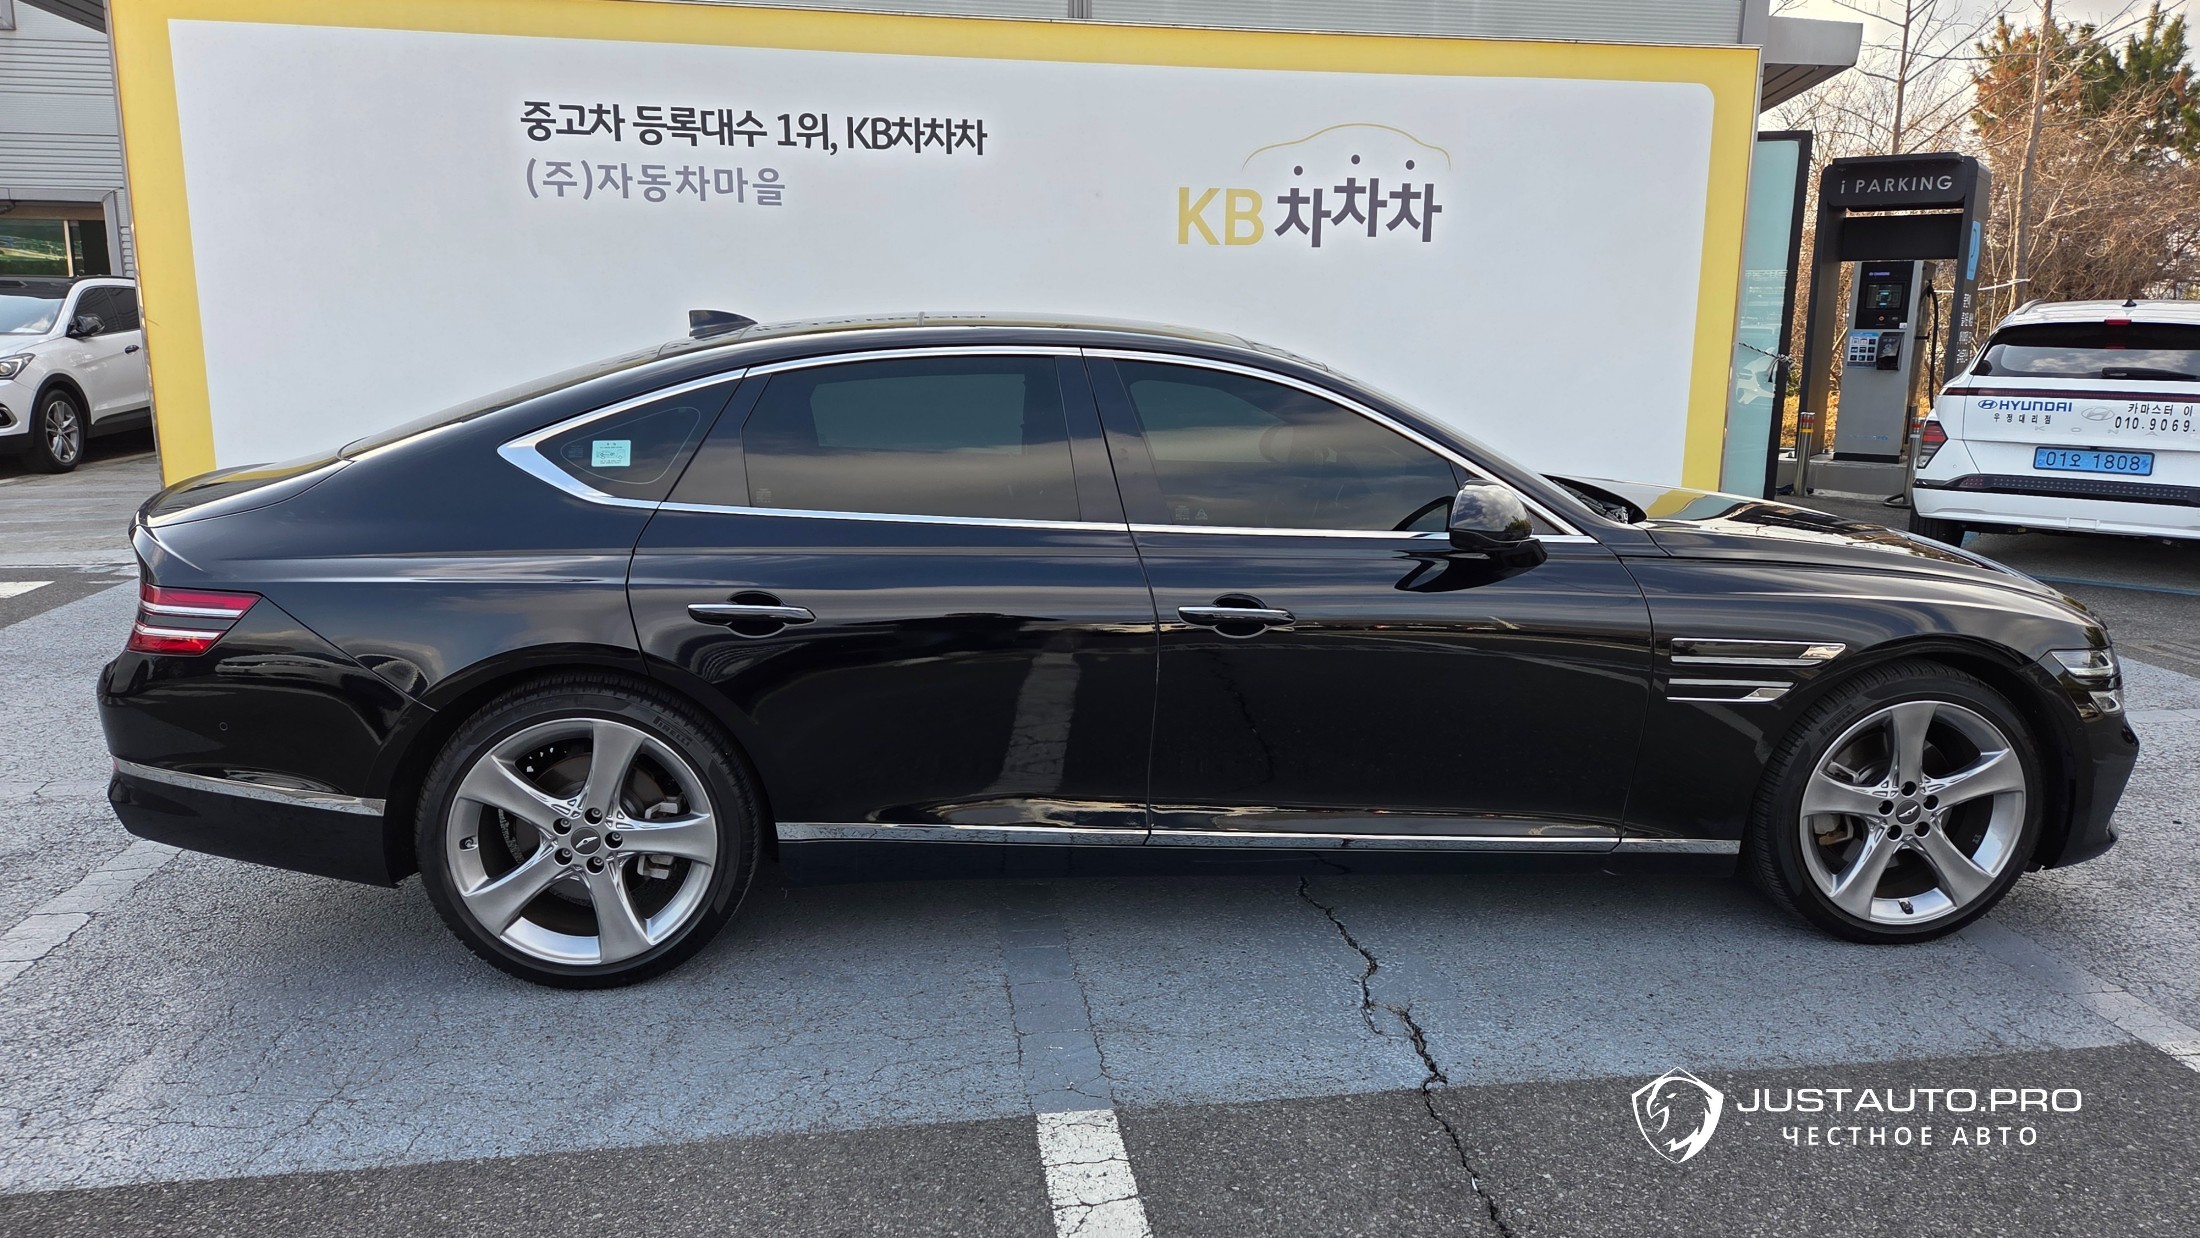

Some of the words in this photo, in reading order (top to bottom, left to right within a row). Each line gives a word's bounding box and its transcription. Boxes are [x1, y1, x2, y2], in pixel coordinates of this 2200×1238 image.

[520, 100, 625, 142] 중고차
[632, 105, 768, 148] 등록대수
[776, 112, 838, 156] 1위,
[846, 115, 988, 156] KB차차차
[525, 157, 786, 206] (주)자동차마을
[1855, 175, 1953, 193] PARKING
[1177, 186, 1265, 246] KB
[1274, 154, 1443, 248] 차차차
[1999, 400, 2073, 412] HYUNDAI
[2127, 403, 2174, 416] 카마스터
[2045, 451, 2081, 467] 01오
[2094, 454, 2141, 471] 1808
